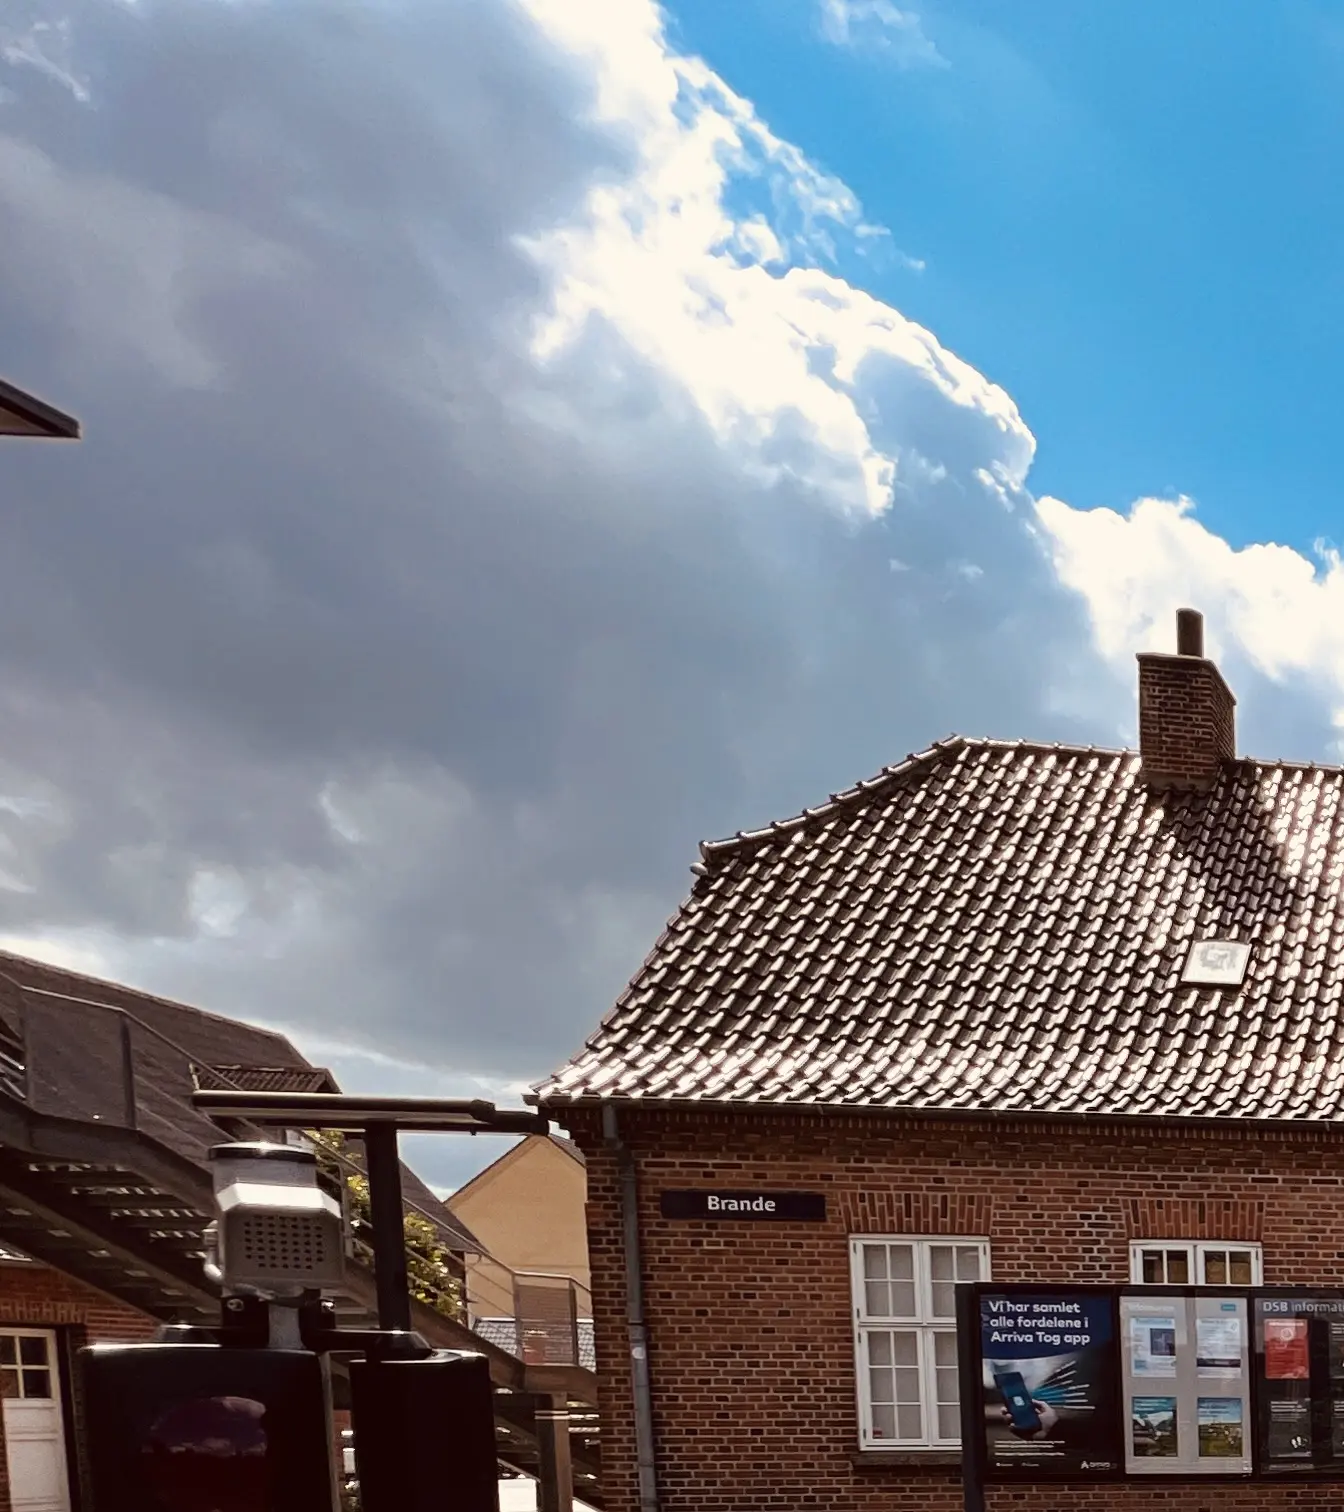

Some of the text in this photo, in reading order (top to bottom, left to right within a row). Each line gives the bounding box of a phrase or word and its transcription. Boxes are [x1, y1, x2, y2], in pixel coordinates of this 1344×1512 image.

[707, 1195, 776, 1212] Brande
[988, 1300, 1081, 1313] Vi har samlet
[1263, 1301, 1289, 1312] DSB
[989, 1316, 1089, 1328] alle fordelene i
[990, 1331, 1090, 1346] Arriva Tog app
